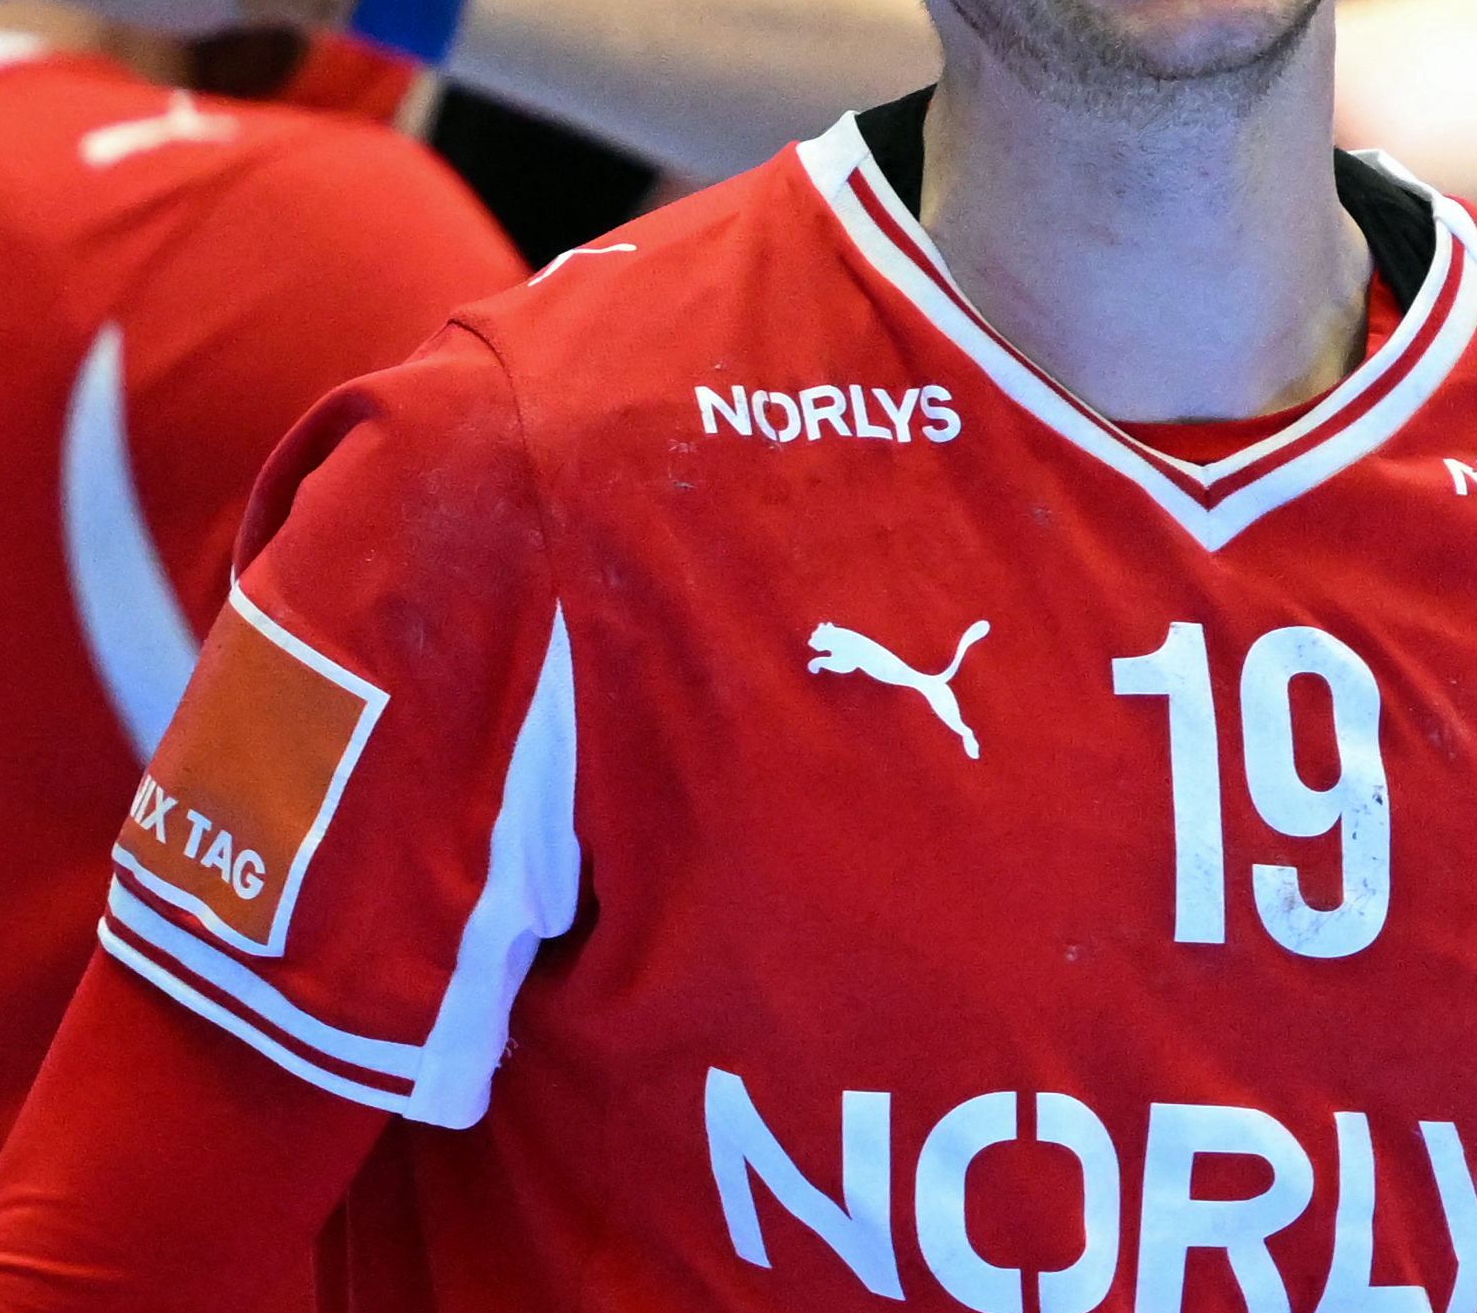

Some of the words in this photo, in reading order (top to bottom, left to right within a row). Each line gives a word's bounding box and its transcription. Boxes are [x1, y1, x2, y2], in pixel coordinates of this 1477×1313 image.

[694, 384, 961, 443] NORLYS
[1112, 622, 1391, 958] 19
[183, 808, 266, 900] TAG
